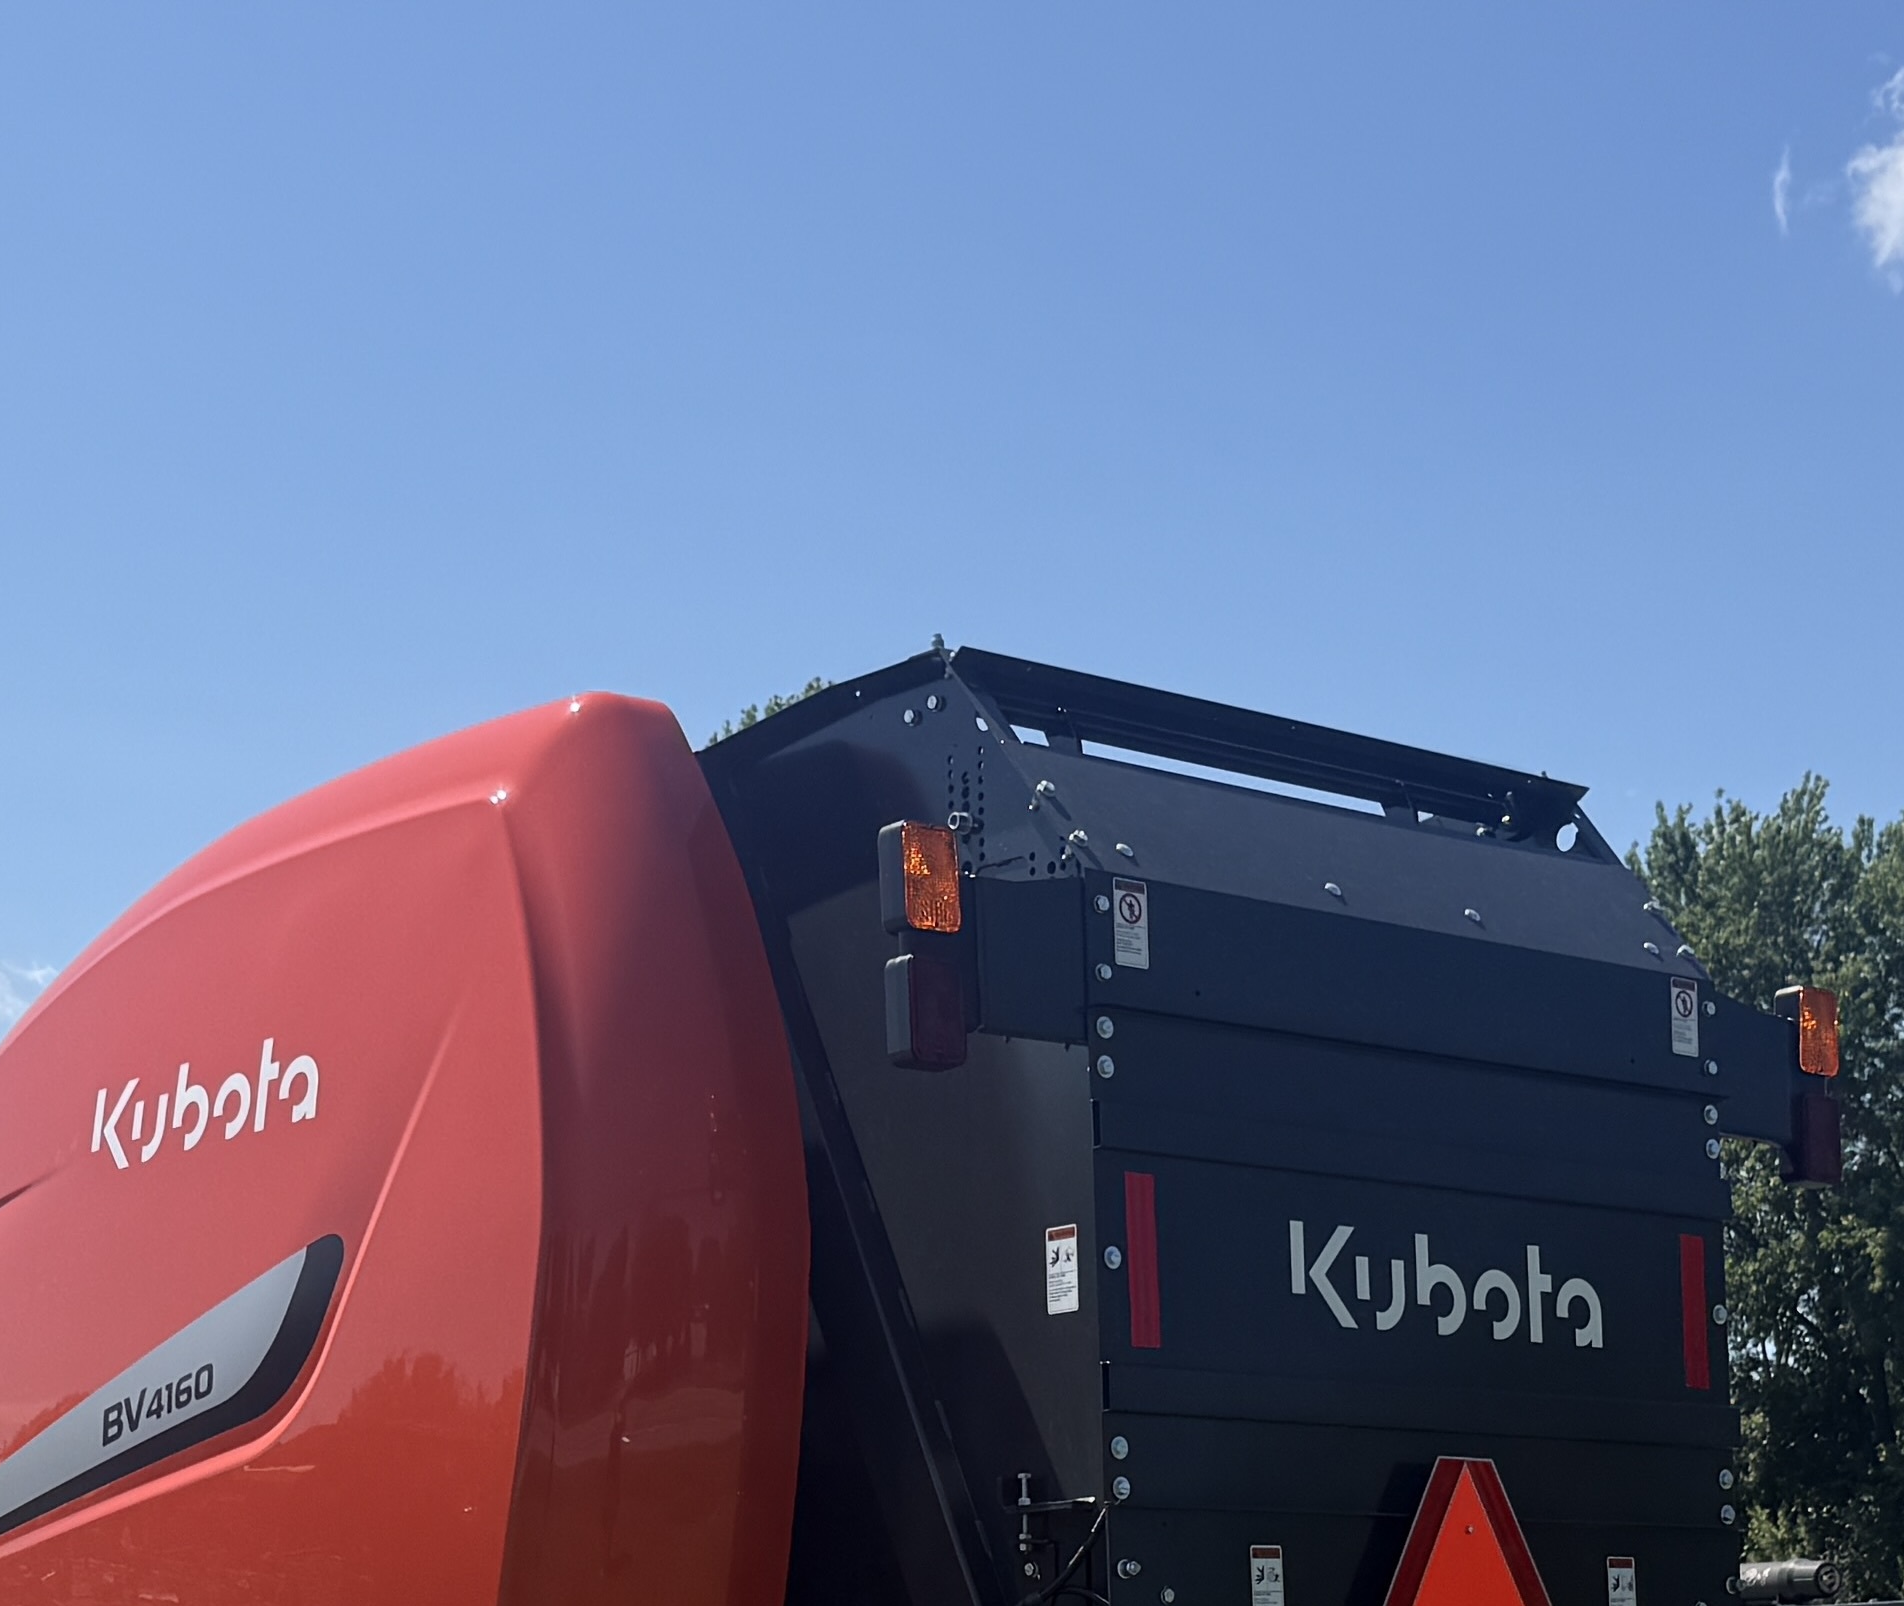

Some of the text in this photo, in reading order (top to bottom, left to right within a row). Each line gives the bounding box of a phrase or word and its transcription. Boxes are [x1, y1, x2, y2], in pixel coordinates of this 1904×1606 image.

[91, 1037, 319, 1170] Kubota
[1289, 1219, 1604, 1348] Kubota
[102, 1363, 214, 1448] BV4160
